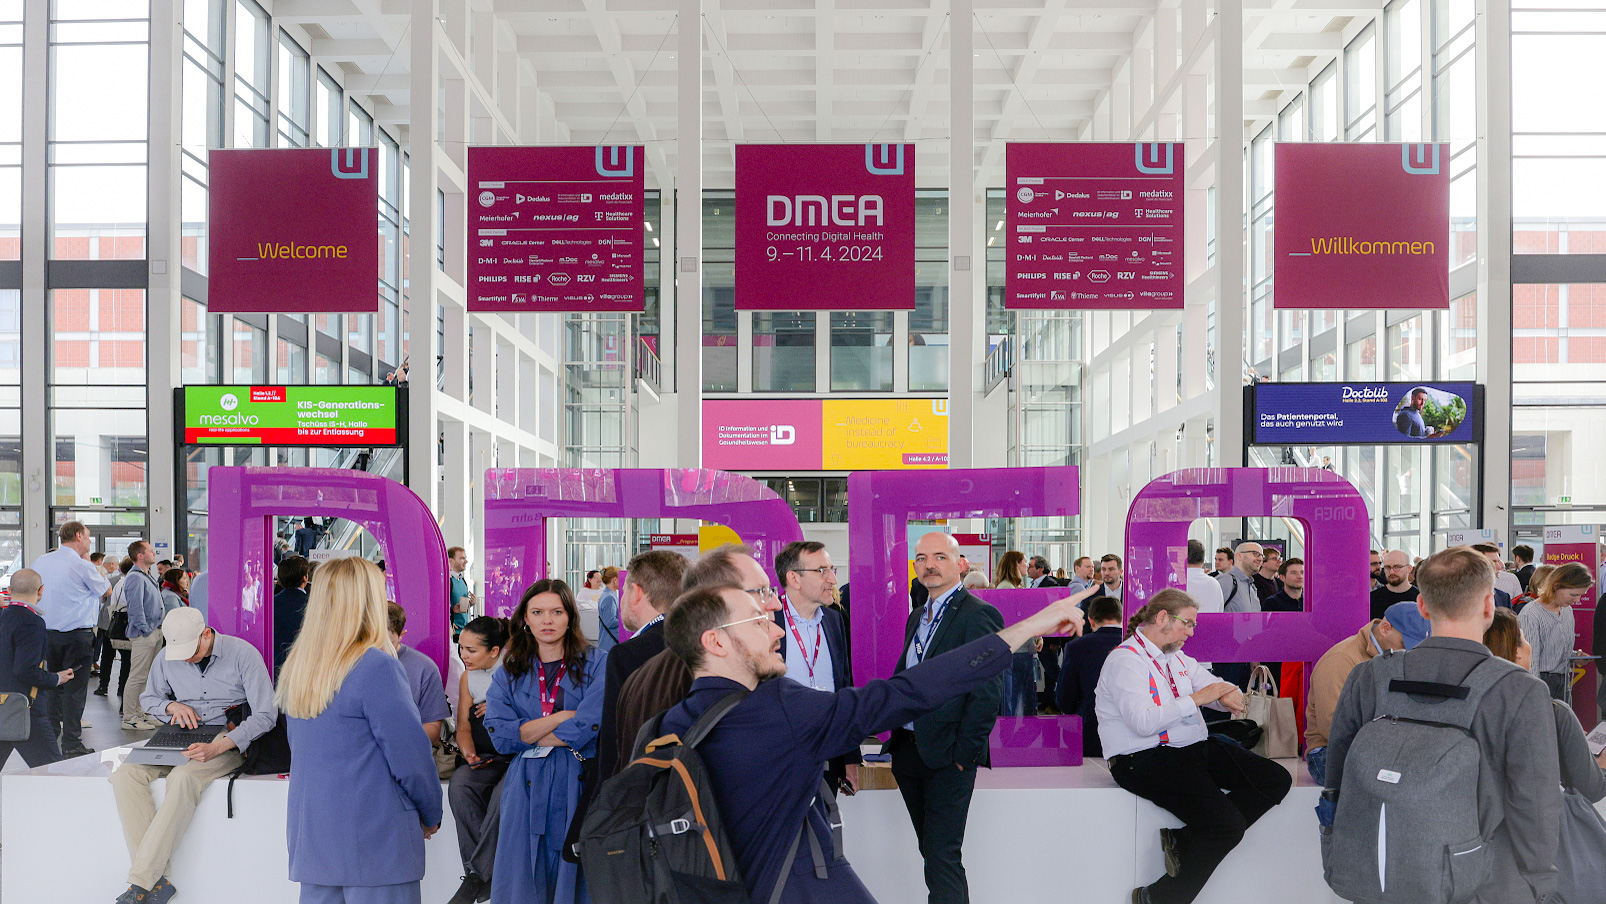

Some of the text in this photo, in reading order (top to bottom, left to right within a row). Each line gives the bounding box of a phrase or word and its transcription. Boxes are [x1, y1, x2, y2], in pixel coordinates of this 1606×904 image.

[600, 192, 633, 200] medatixx
[1139, 190, 1173, 198] medatixx
[767, 195, 884, 226] DMEA
[766, 232, 884, 243] Connecting Digital Health
[480, 239, 493, 247] 3M
[577, 274, 595, 282] RZV
[1342, 386, 1388, 398] Doctolib
[297, 401, 385, 410] KIS-Generations-
[200, 412, 259, 425] mesalvo
[297, 410, 338, 419] wechsel
[1260, 413, 1338, 422] Das Patientenportal,
[297, 420, 328, 428] Tschüss
[846, 416, 890, 425] Medicine
[1296, 420, 1325, 428] genutzt
[298, 428, 308, 436] bis
[323, 428, 364, 437] Entlassung
[846, 427, 896, 437] instead of
[846, 439, 904, 449] bureaucracy
